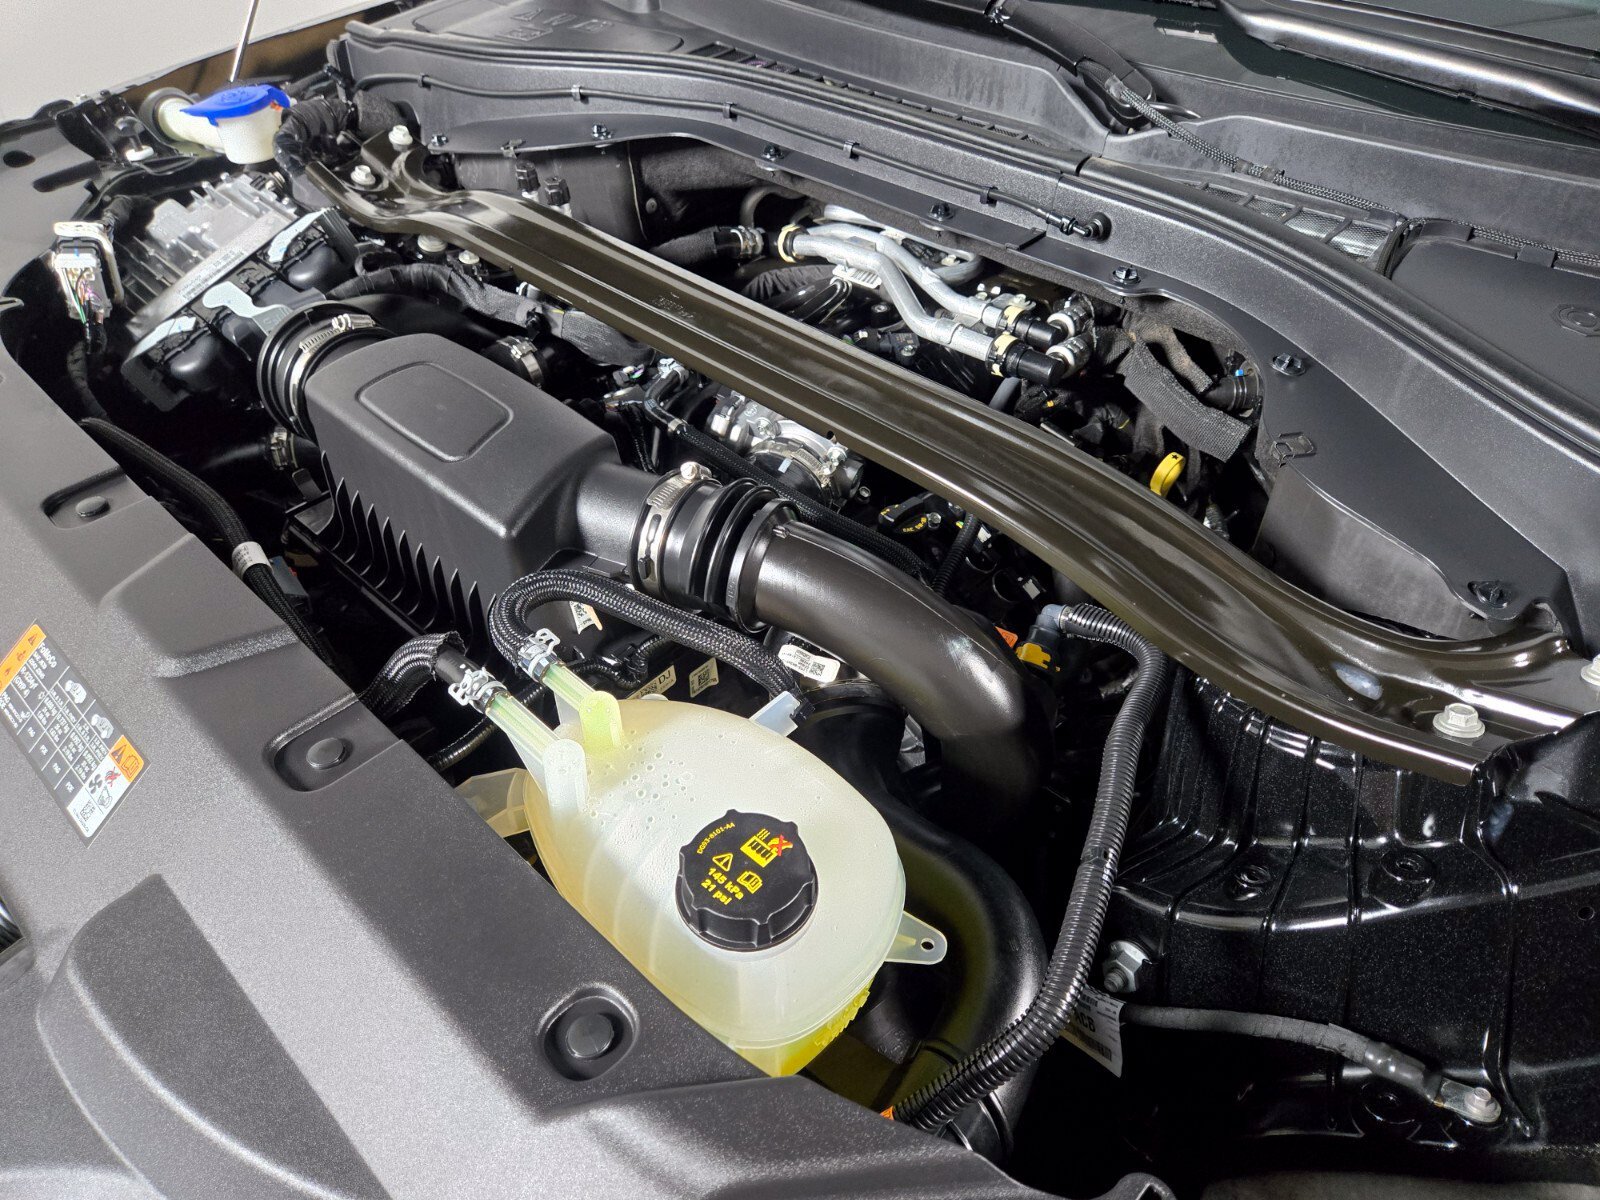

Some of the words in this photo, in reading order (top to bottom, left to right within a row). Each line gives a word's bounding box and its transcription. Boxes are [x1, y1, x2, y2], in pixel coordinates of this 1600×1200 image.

[38, 642, 58, 668] FoMoCo
[658, 671, 671, 685] DJ
[701, 880, 716, 892] 21
[712, 889, 732, 905] psi
[708, 868, 727, 885] 145
[724, 881, 744, 900] kPa
